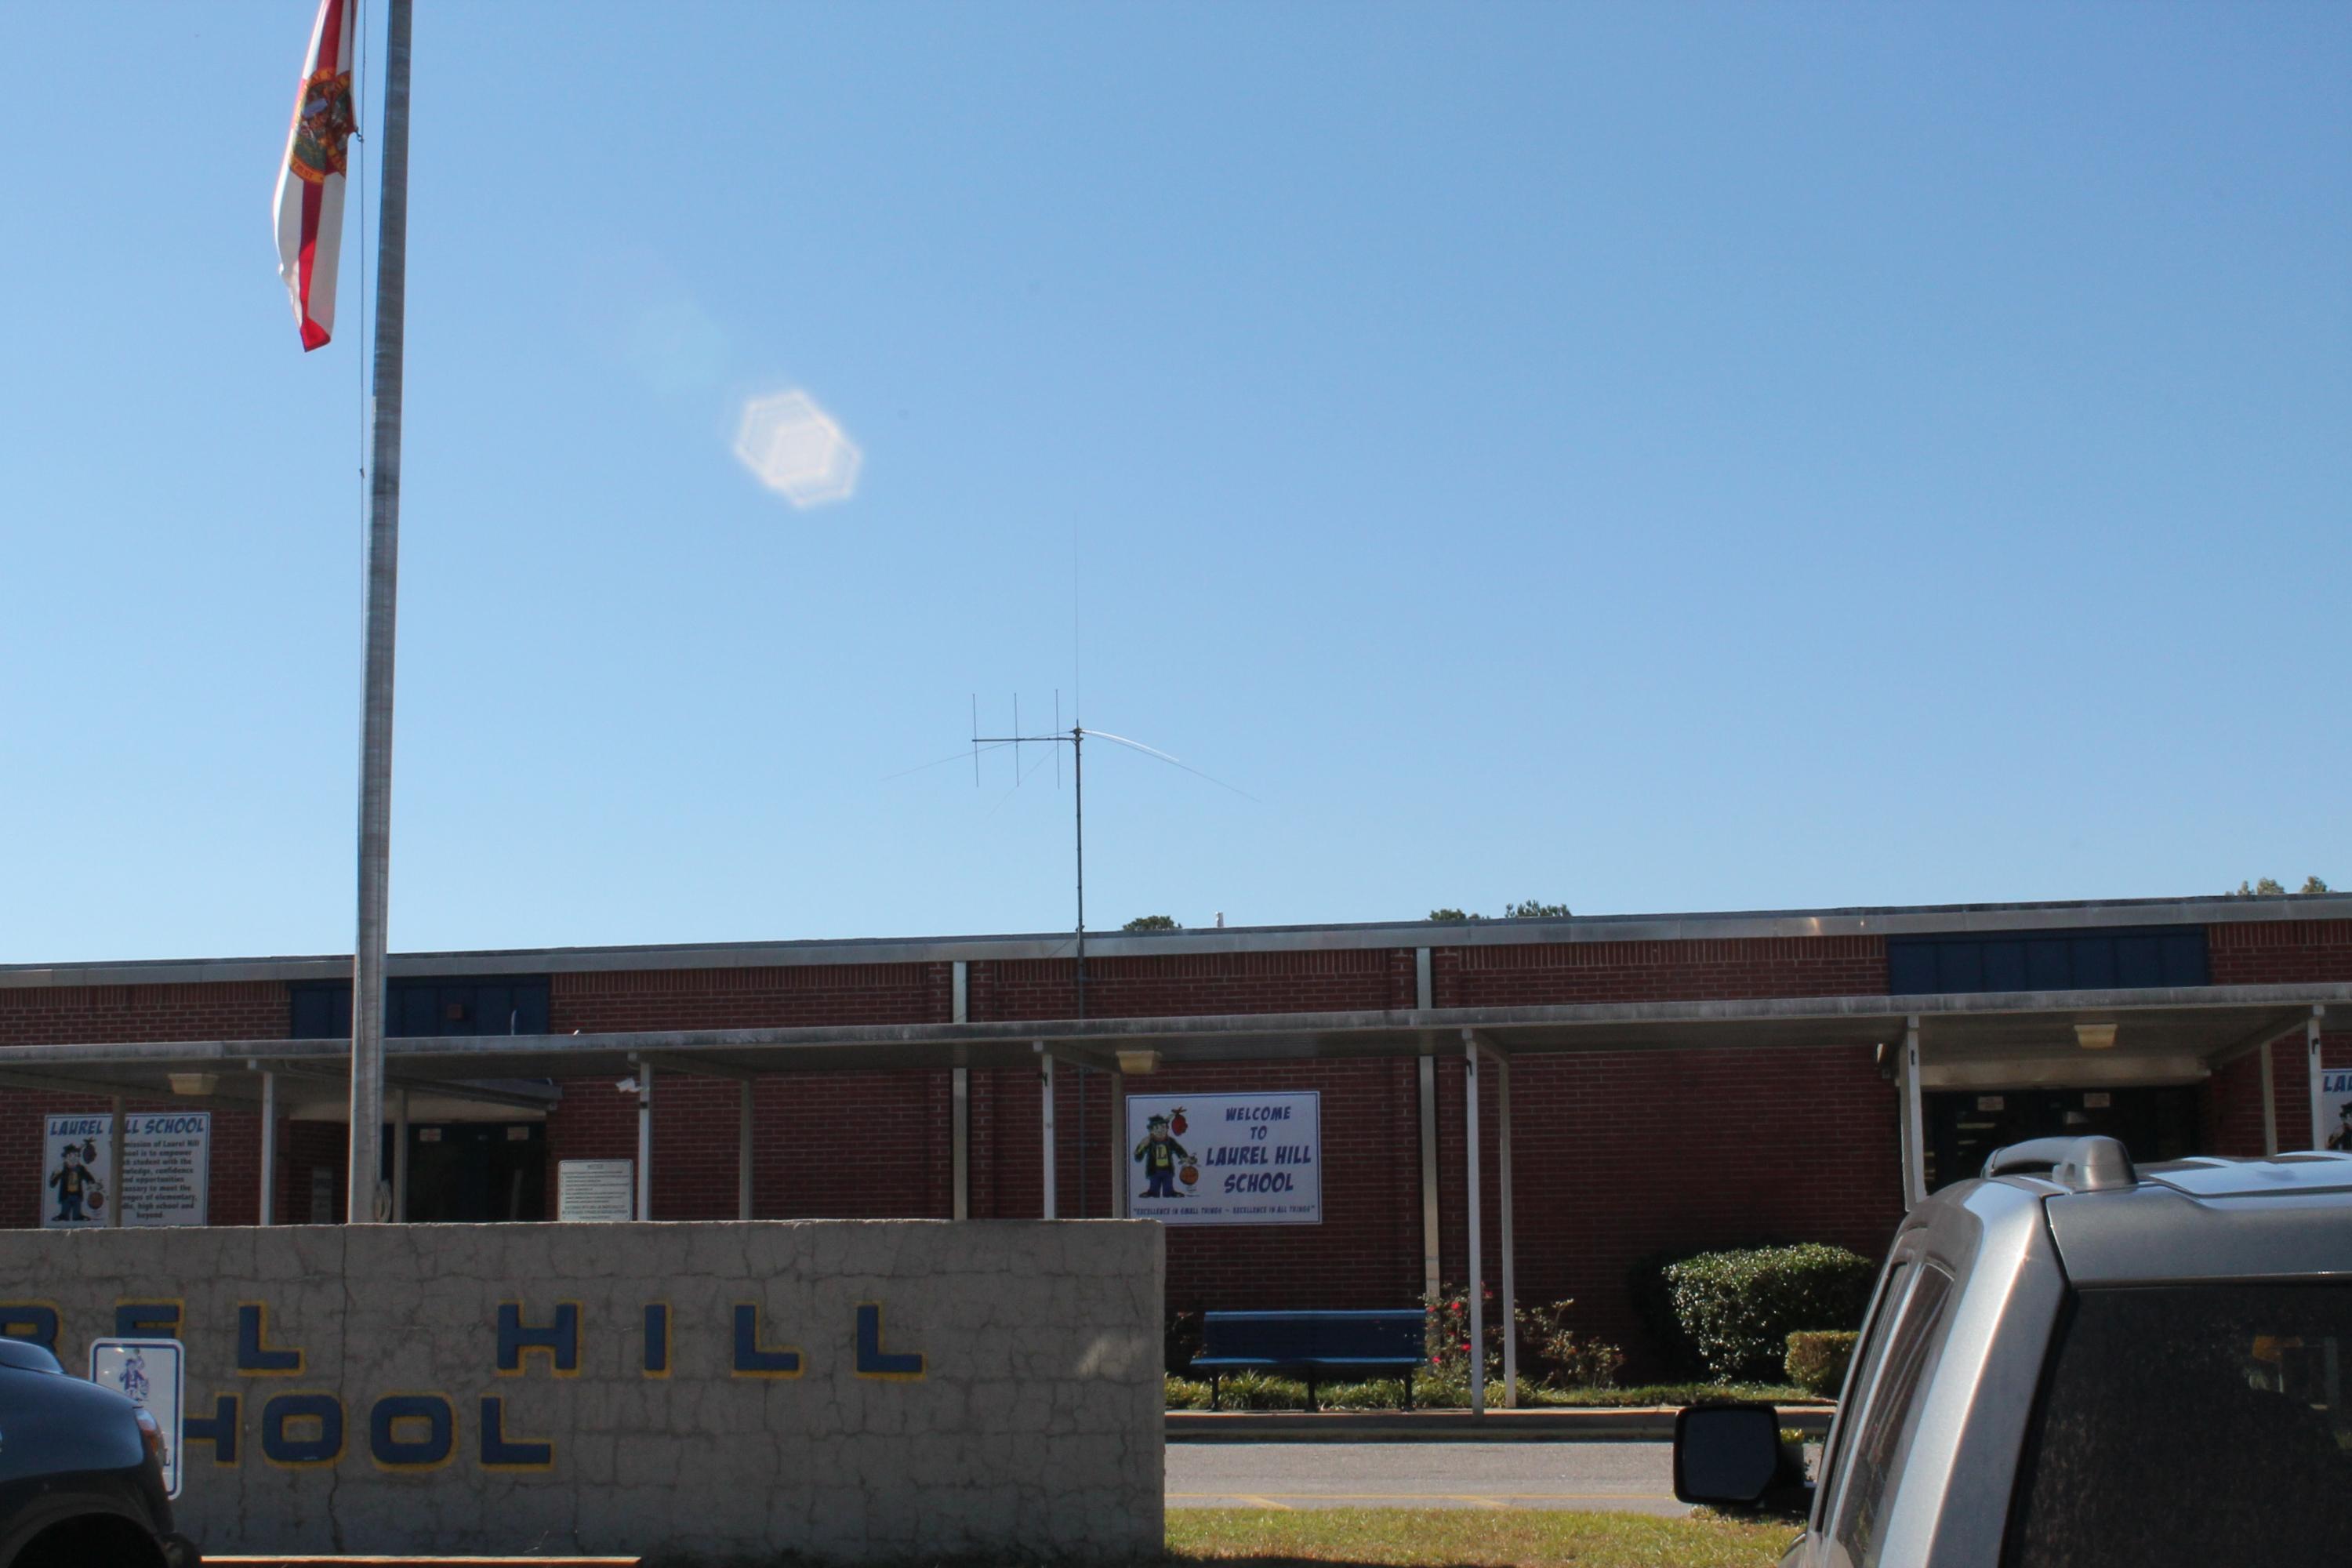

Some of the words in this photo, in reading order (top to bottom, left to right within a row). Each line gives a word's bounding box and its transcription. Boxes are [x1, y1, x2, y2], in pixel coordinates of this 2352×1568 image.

[1225, 1106, 1291, 1121] WELCOME
[50, 1120, 103, 1135] LAUREL
[108, 1118, 140, 1134] LL
[144, 1117, 204, 1134] SCHOOL
[1250, 1125, 1268, 1140] TO
[1205, 1145, 1269, 1166] LAUREL
[1275, 1145, 1311, 1165] HILL
[1224, 1171, 1294, 1193] SCHOOL
[495, 1299, 927, 1381] HILL
